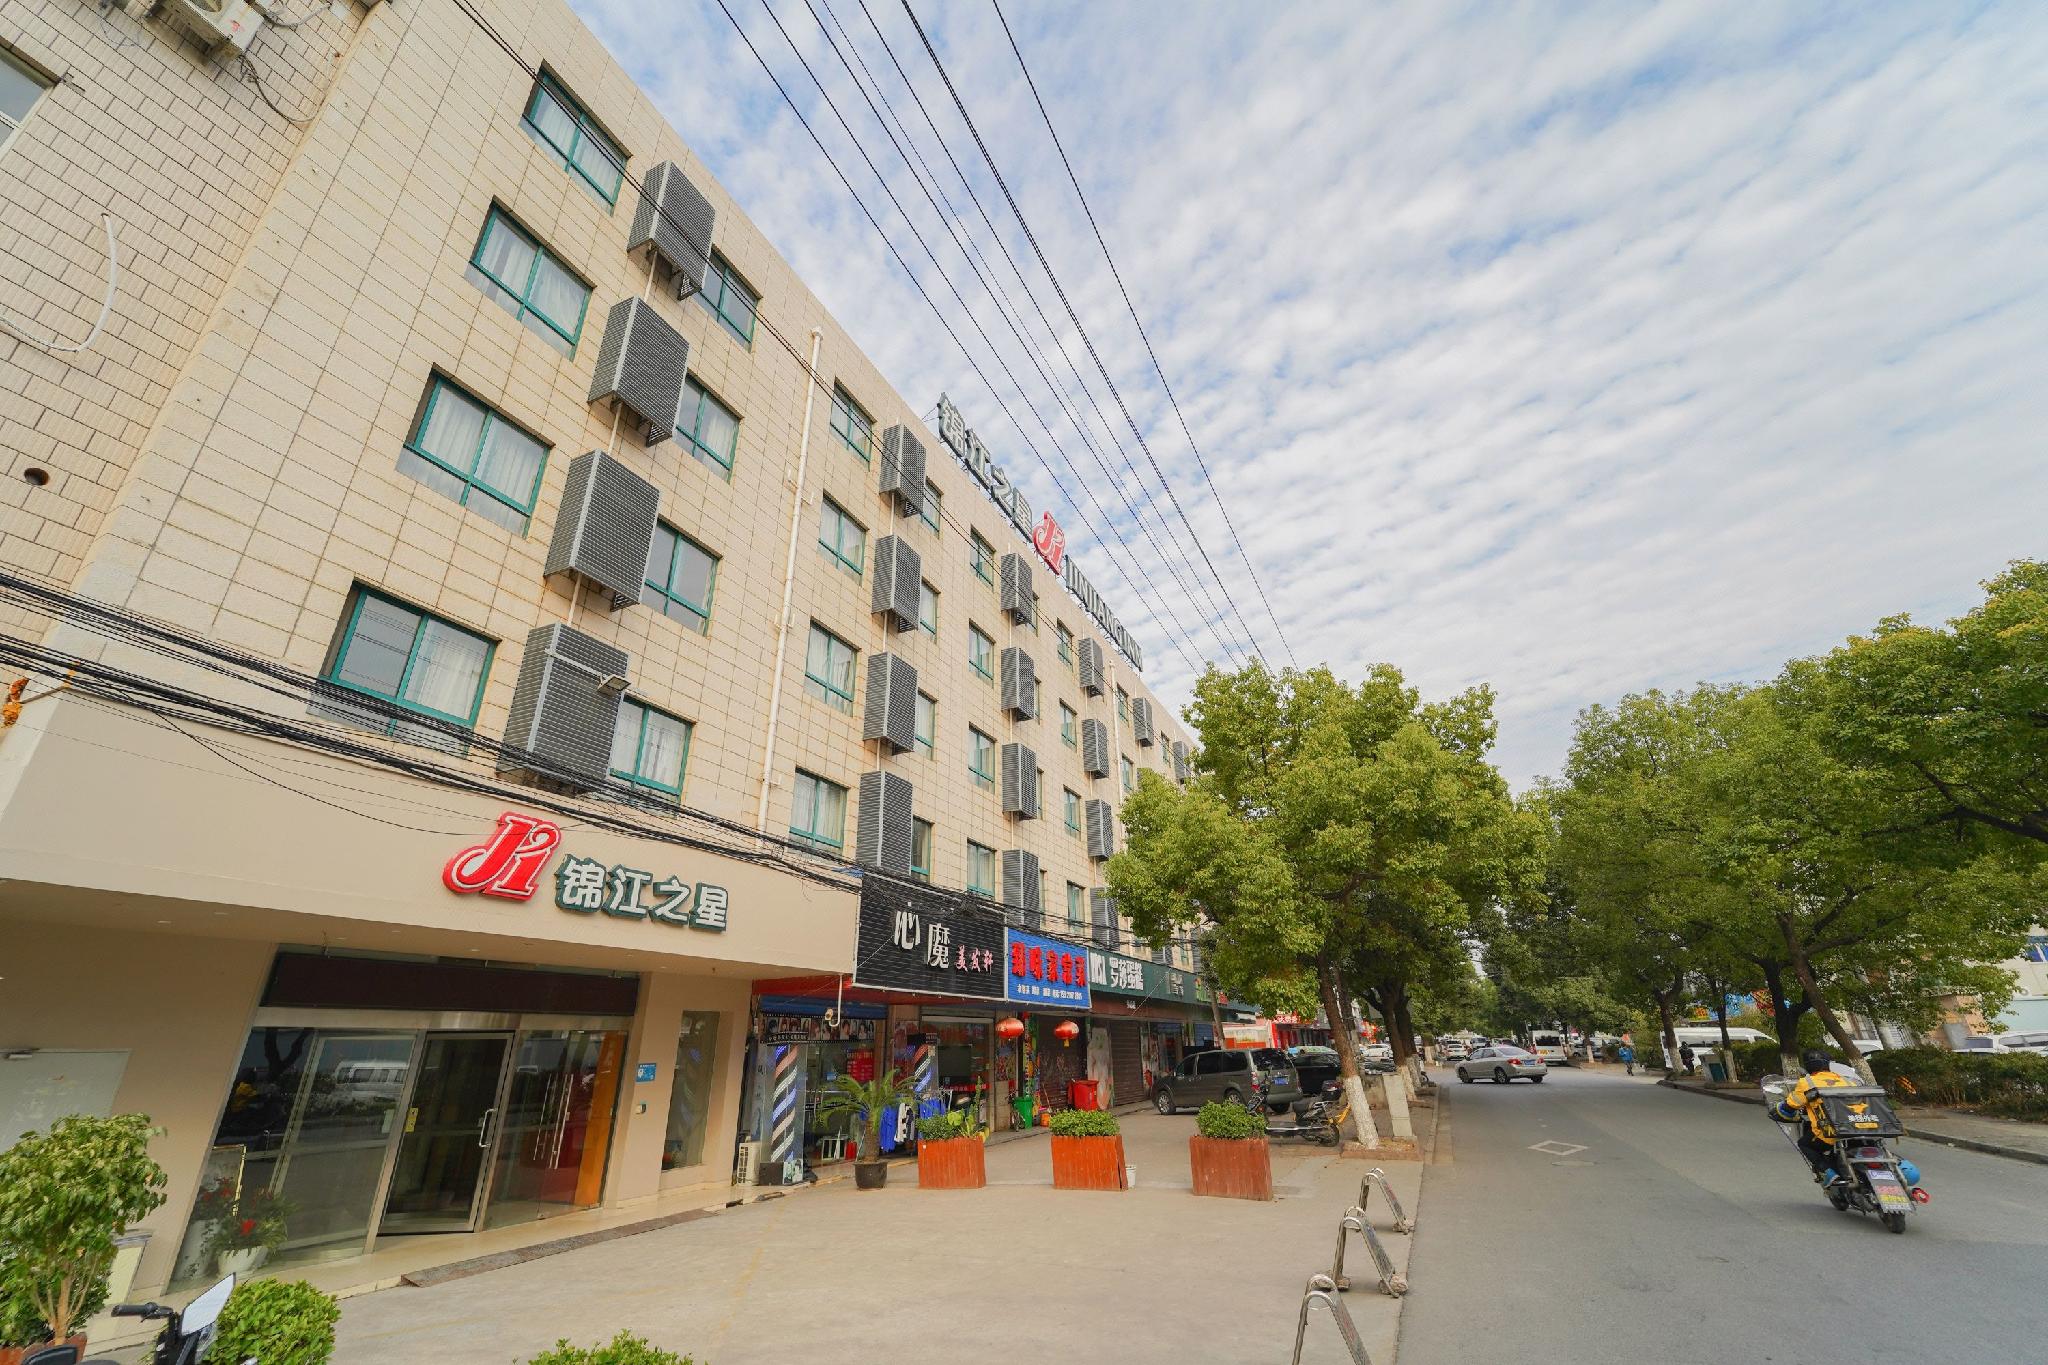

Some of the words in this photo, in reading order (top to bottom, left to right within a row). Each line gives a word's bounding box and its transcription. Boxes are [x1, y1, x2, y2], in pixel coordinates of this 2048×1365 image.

[938, 392, 1034, 543] 锦江之星
[554, 852, 729, 932] 锦江之星
[894, 901, 950, 969] 心魔
